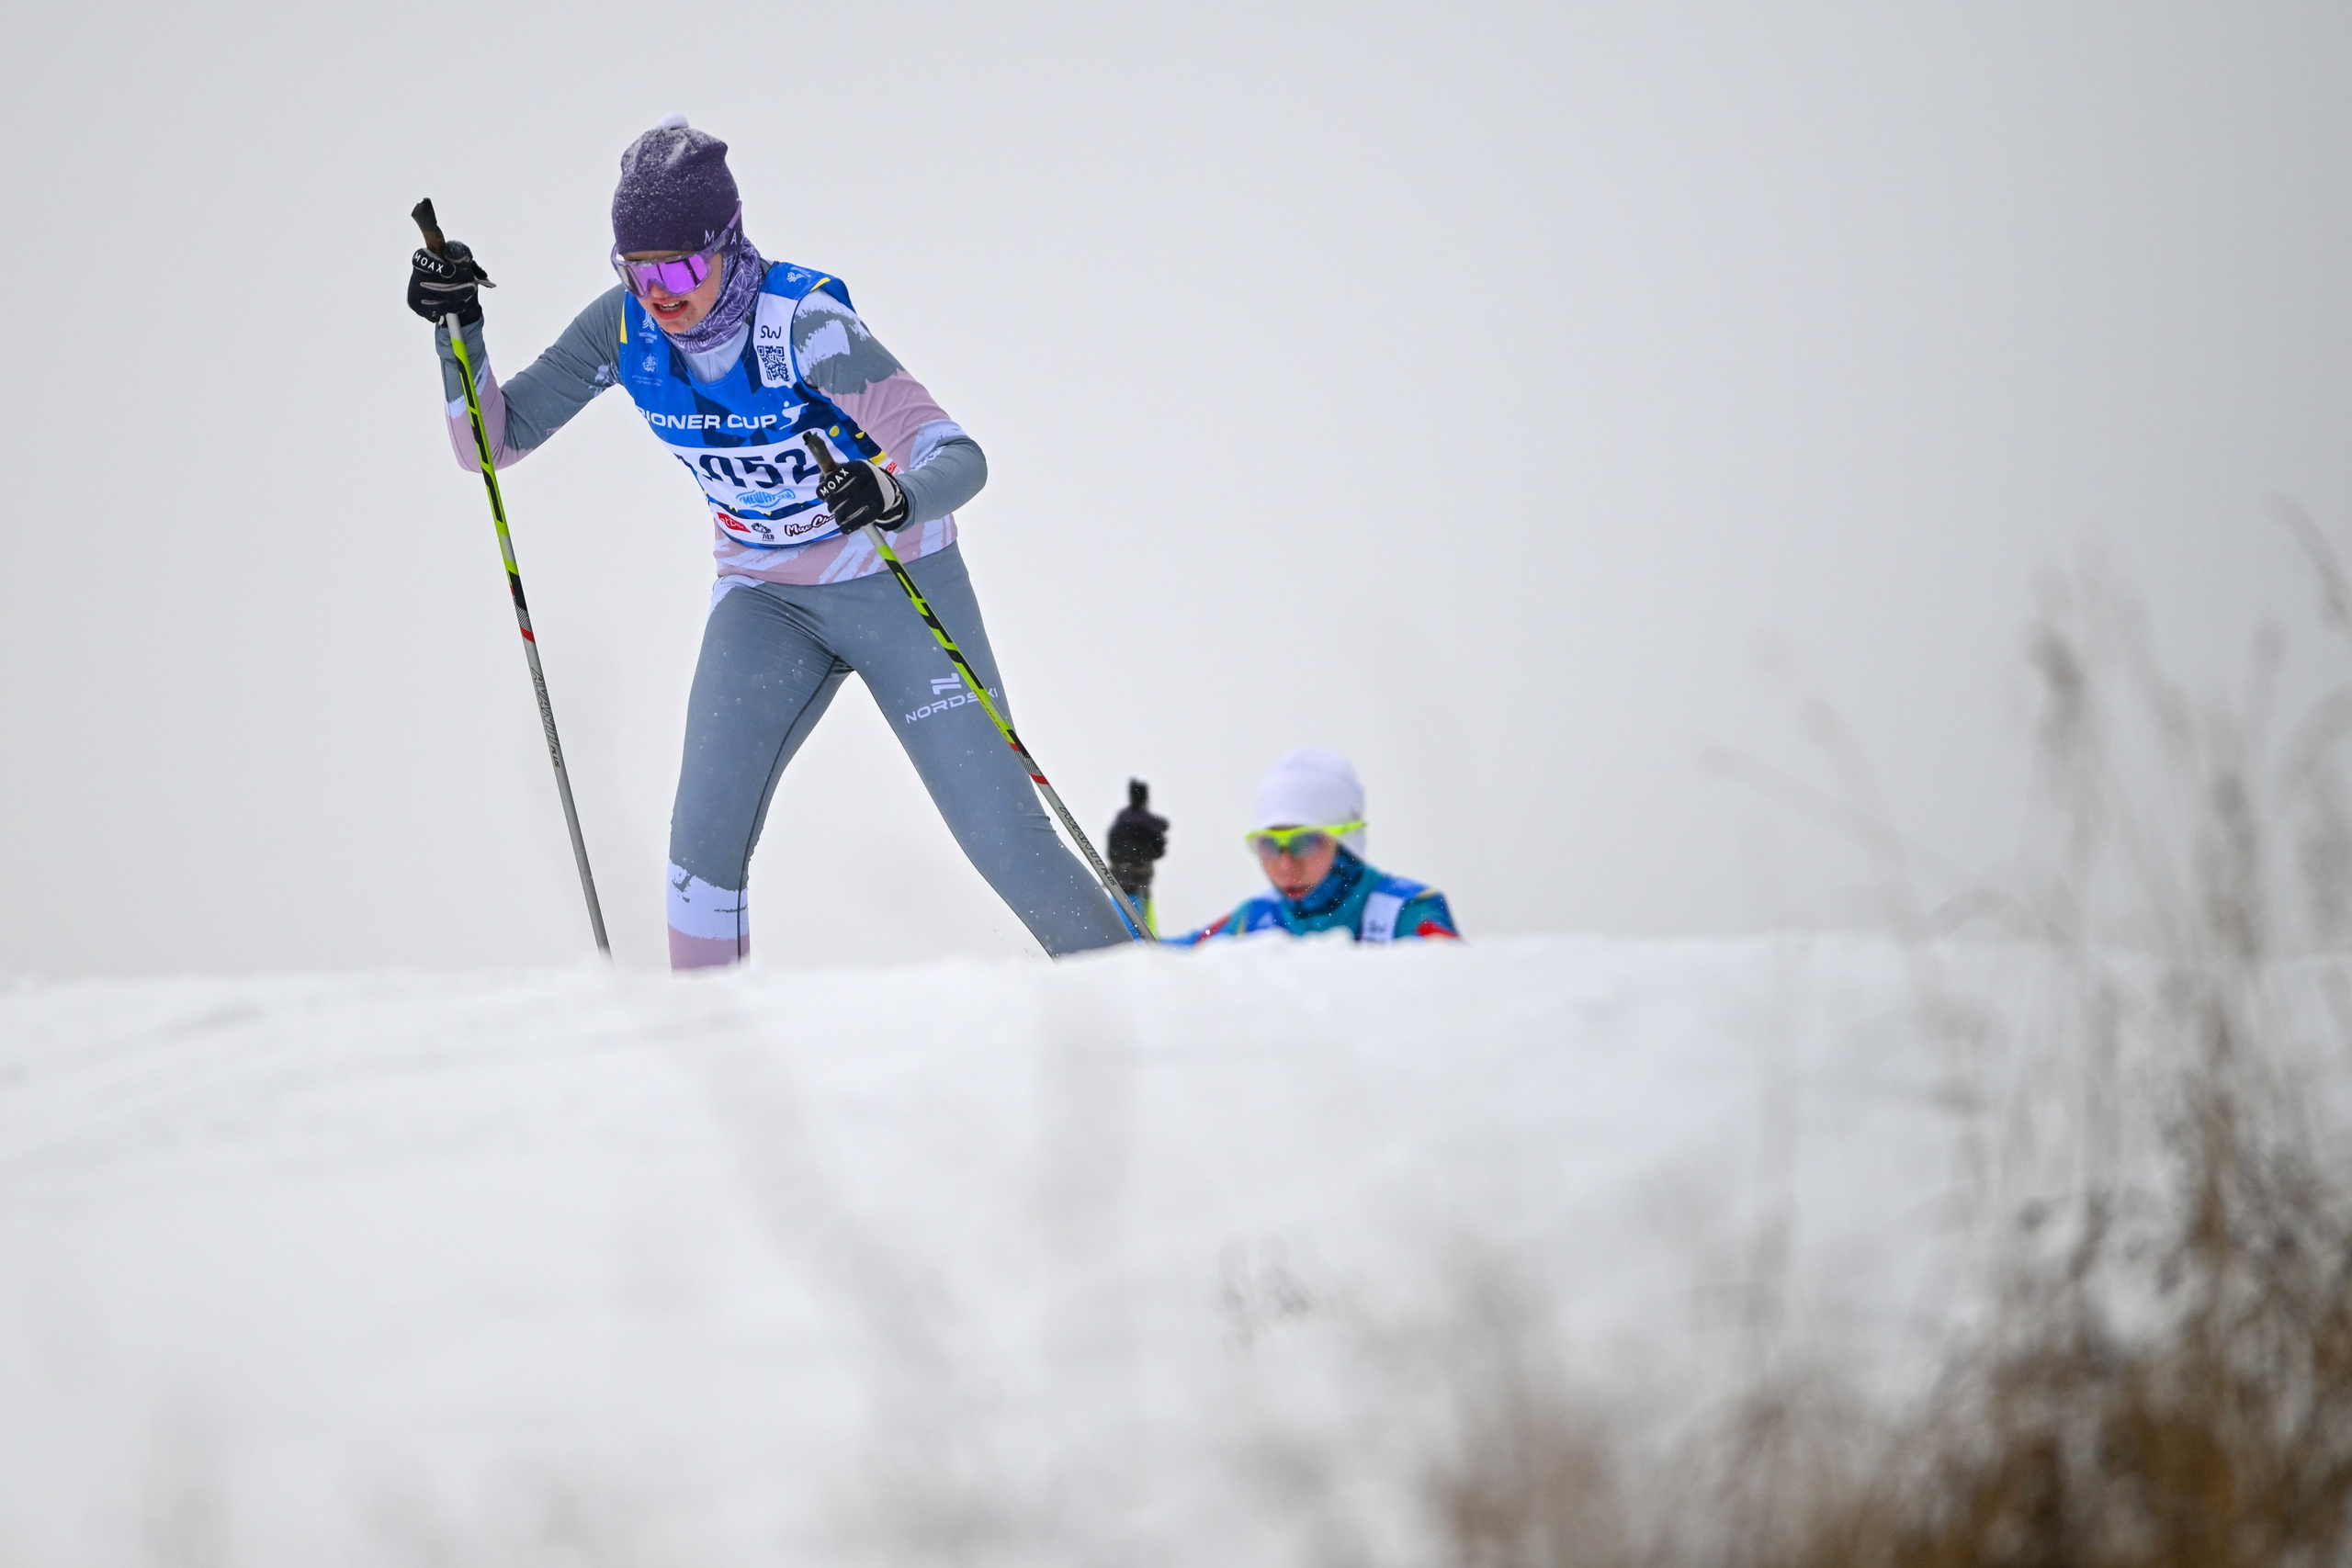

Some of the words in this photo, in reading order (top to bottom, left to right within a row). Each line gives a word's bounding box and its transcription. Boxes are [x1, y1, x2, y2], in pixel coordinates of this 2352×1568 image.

[704, 230, 745, 245] MA
[413, 252, 444, 274] MOAX
[727, 413, 778, 429] CUP
[673, 447, 820, 489] 052
[820, 468, 849, 496] MOAX
